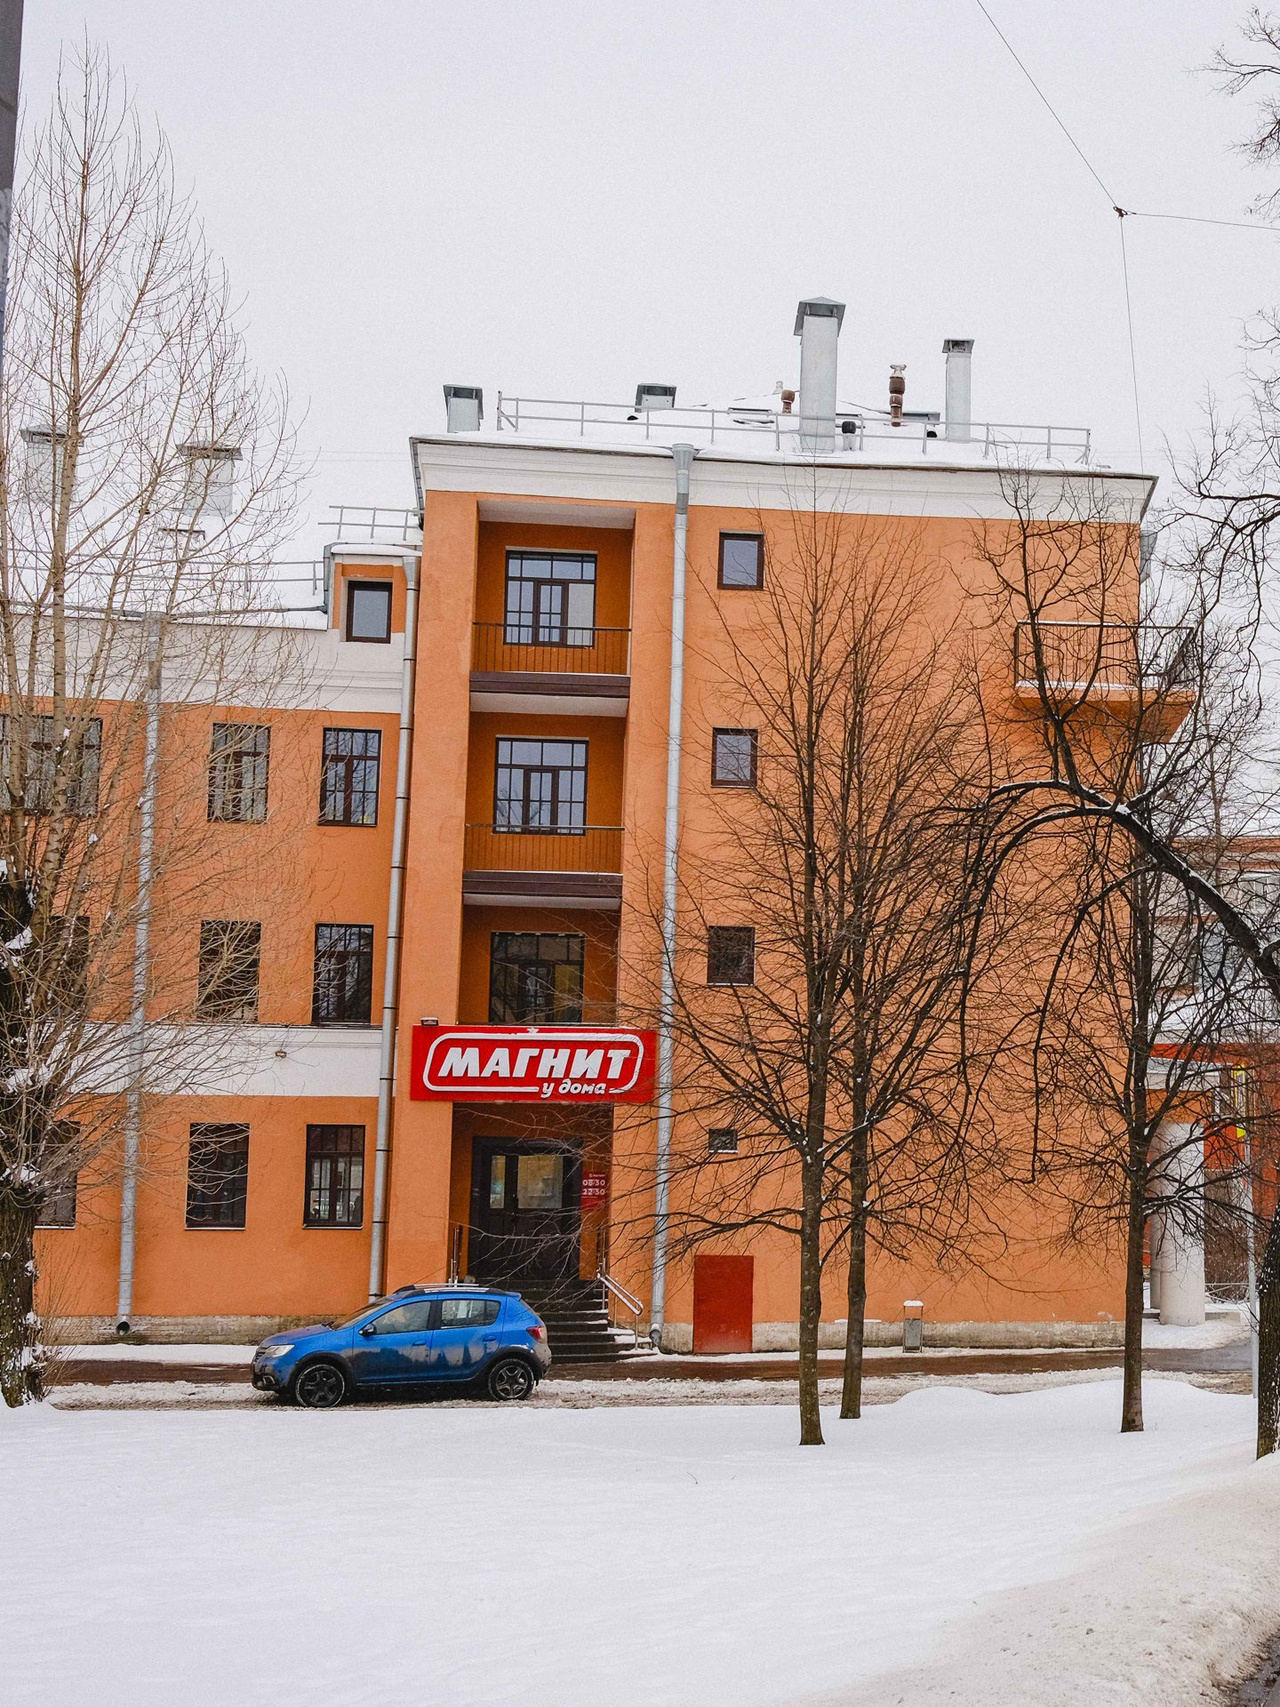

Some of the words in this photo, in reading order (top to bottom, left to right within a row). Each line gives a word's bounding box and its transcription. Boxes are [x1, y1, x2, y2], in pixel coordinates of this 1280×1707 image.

[437, 1047, 632, 1080] МАГНИТ
[540, 1081, 556, 1099] у
[558, 1078, 607, 1096] дома
